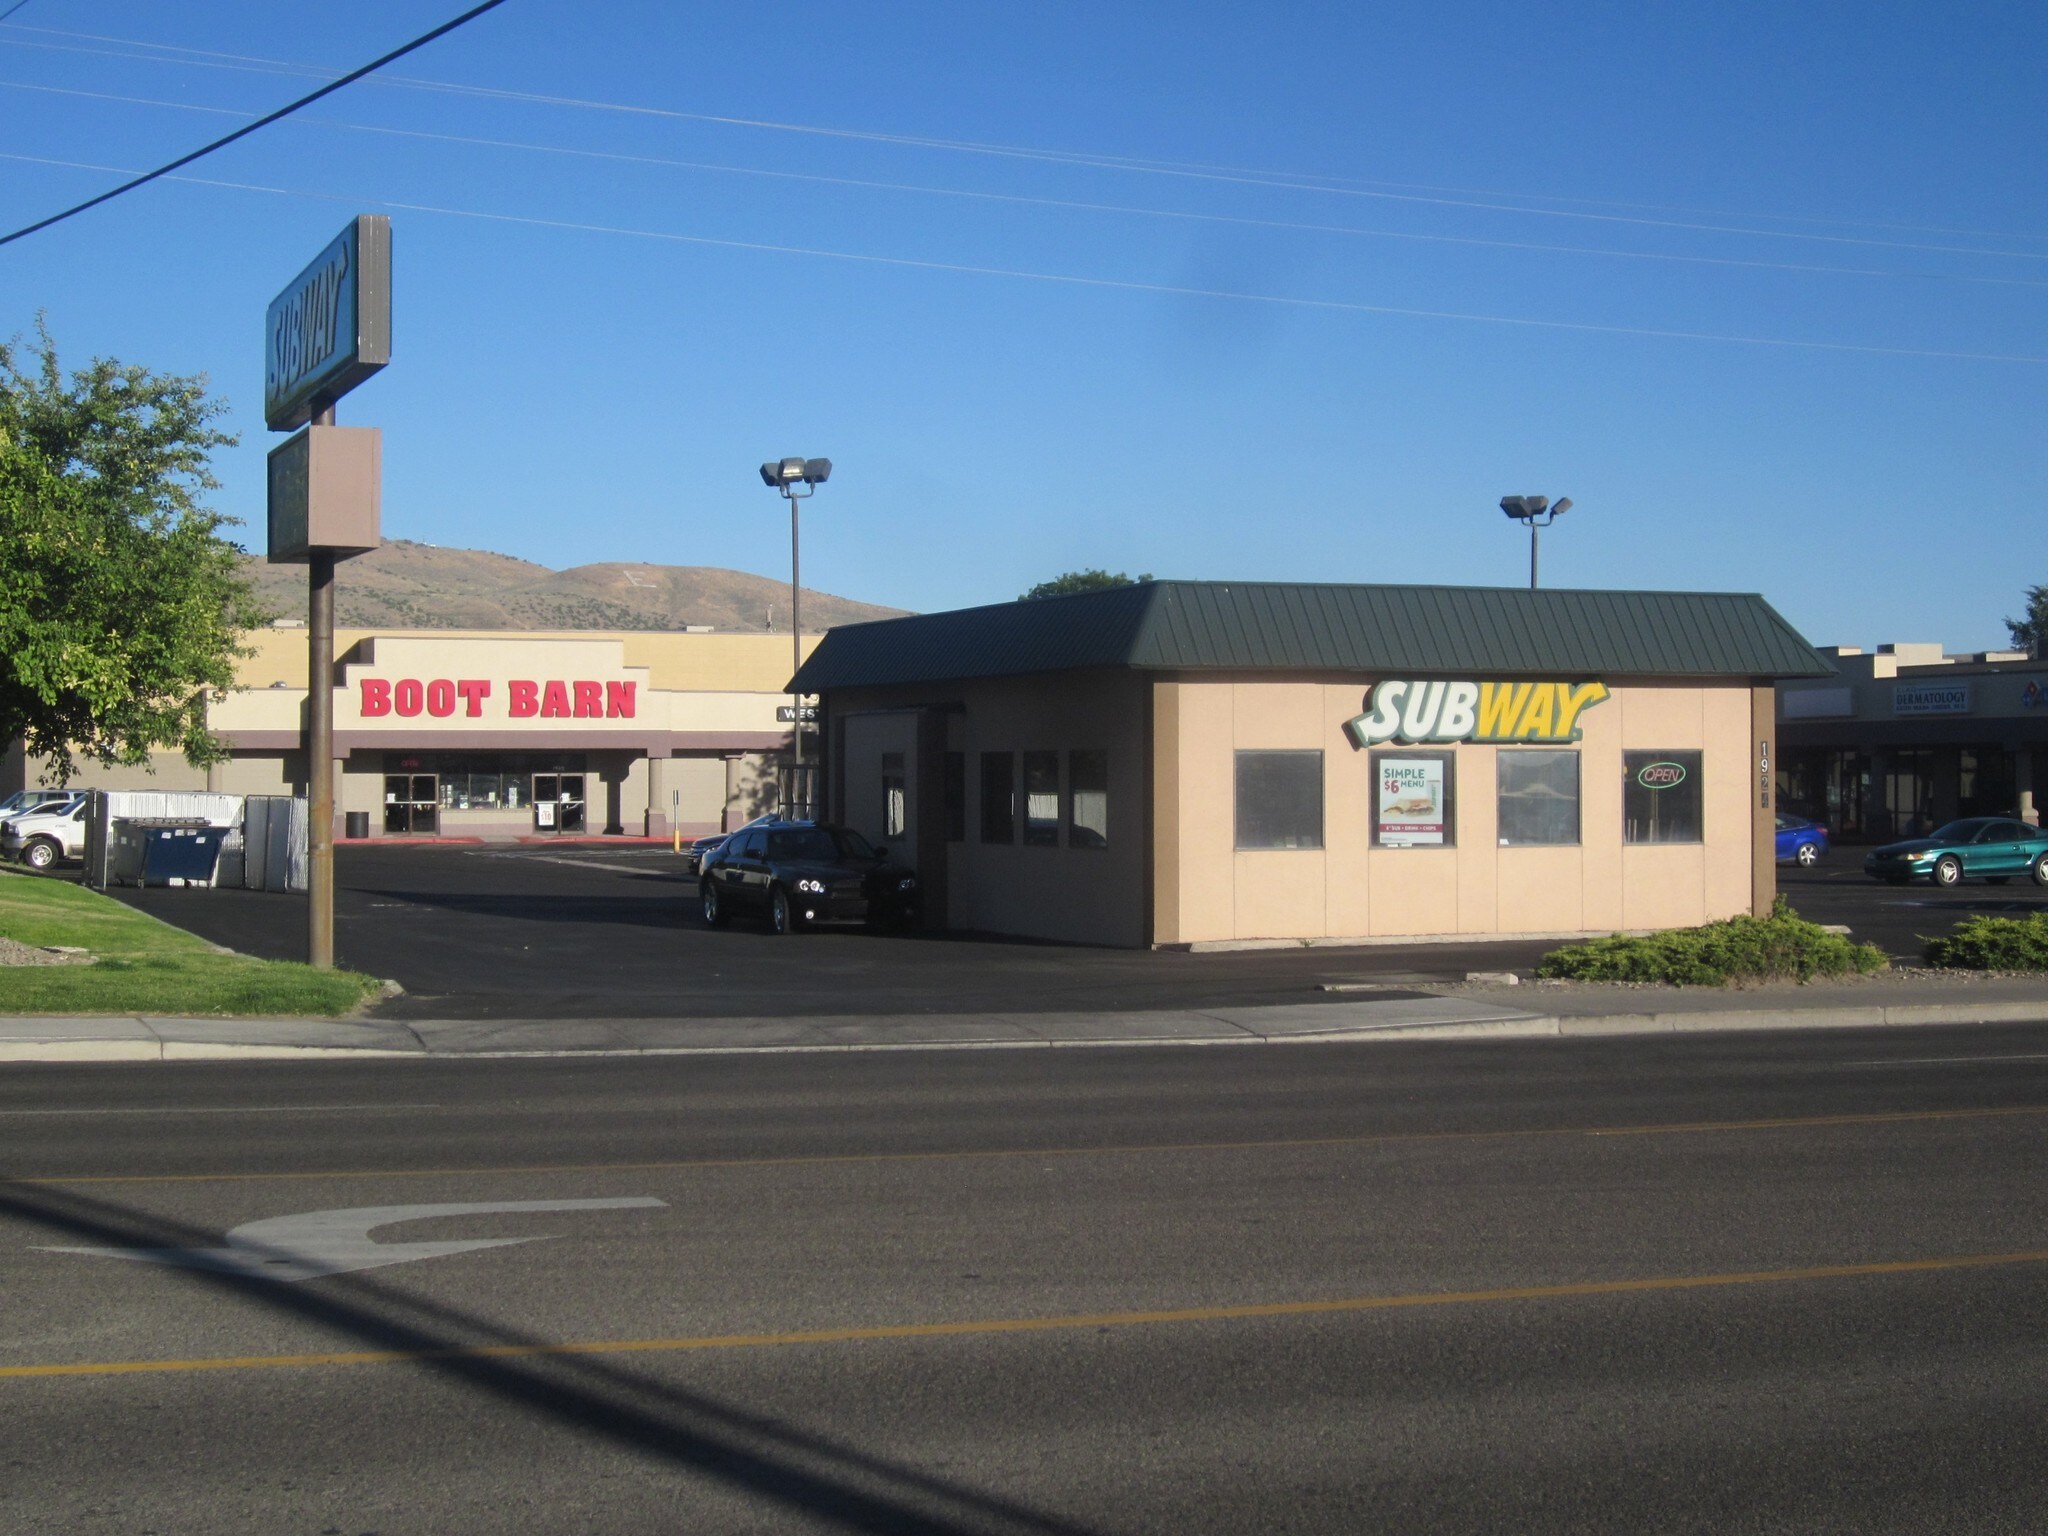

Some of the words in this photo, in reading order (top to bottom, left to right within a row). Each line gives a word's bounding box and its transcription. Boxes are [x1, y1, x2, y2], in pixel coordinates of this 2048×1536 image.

[270, 241, 349, 402] SUBWAY
[360, 678, 491, 718] BOOT
[508, 680, 637, 719] BARN
[1896, 691, 1966, 705] DERMATOLOGY
[784, 708, 820, 719] WES
[1357, 680, 1608, 742] SUBWAY
[1384, 768, 1425, 779] SIMPLE
[1644, 768, 1680, 783] OPEN
[1384, 779, 1400, 794] $6
[1400, 780, 1425, 788] MENU
